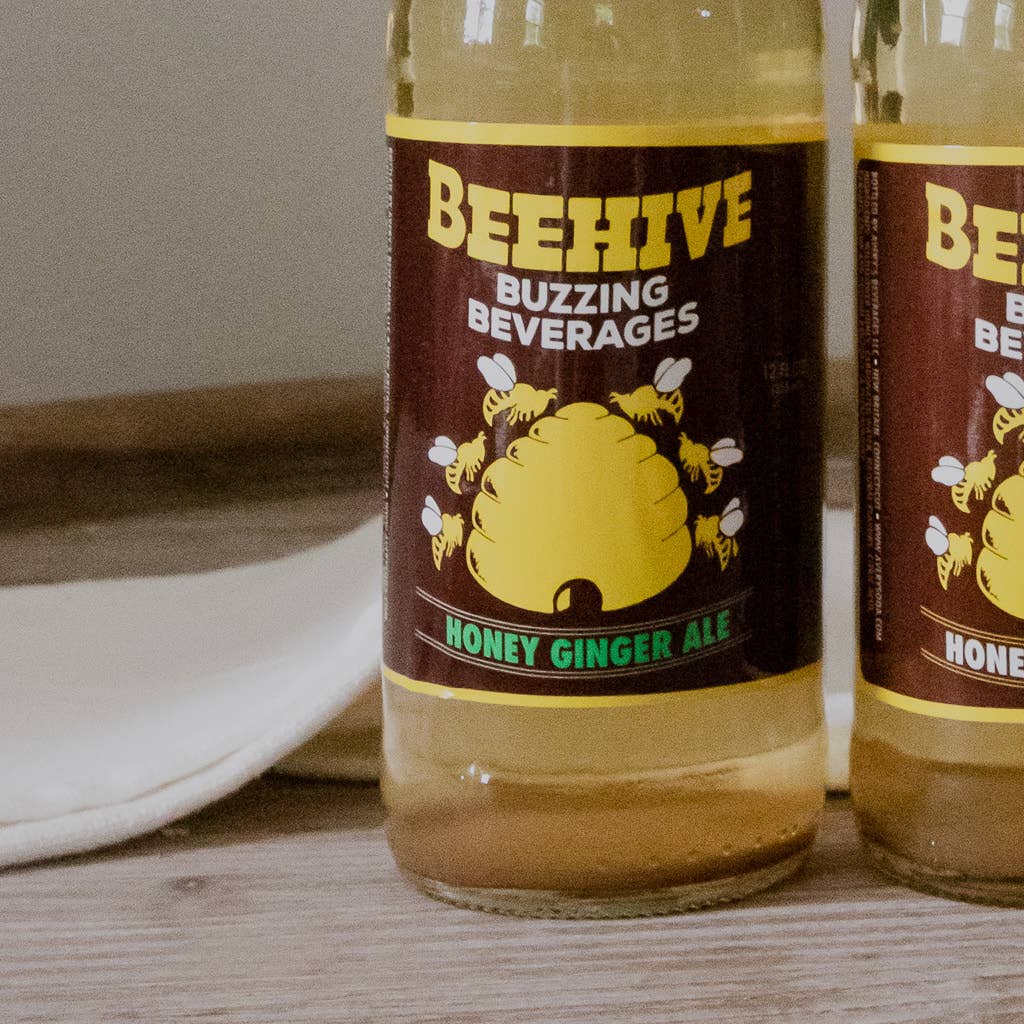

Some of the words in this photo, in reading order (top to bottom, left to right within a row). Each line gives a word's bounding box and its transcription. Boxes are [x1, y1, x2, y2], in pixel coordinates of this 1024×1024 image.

[428, 158, 753, 273] BEEHIVE
[496, 273, 668, 314] BUZZING
[468, 298, 699, 350] BEVERAGES
[446, 614, 540, 666] HONEY
[550, 628, 671, 669] GINGER
[682, 610, 729, 658] ALE
